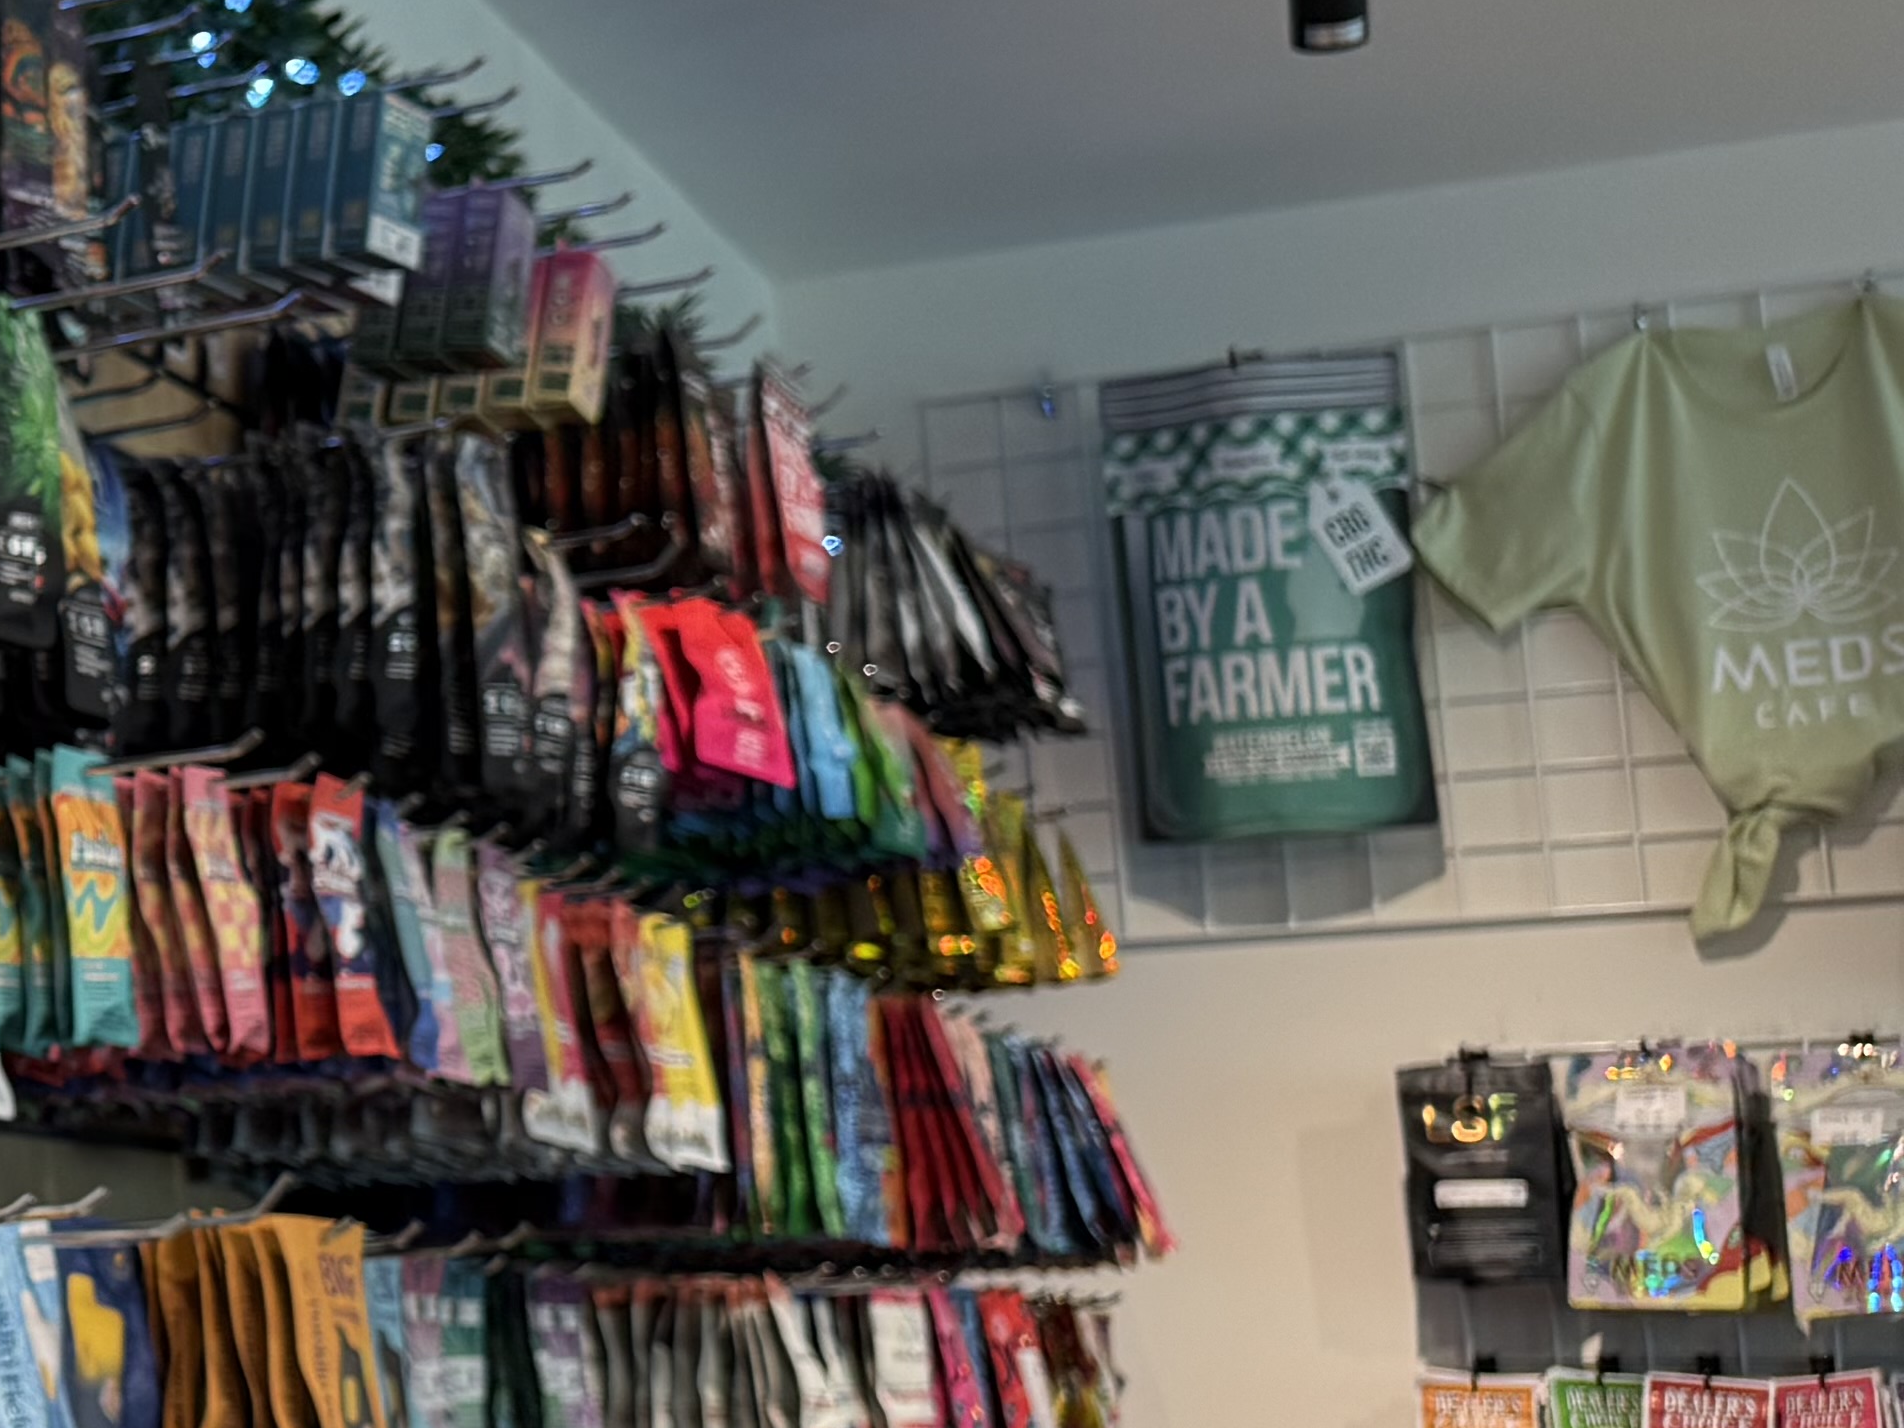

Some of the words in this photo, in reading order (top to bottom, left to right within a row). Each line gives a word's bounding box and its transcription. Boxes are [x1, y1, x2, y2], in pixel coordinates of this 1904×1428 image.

[1153, 500, 1303, 580] MADE
[1344, 536, 1388, 581] THC
[1159, 582, 1218, 649] BY
[1233, 578, 1273, 644] A
[1163, 645, 1381, 728] FARMER
[1710, 630, 1903, 694] MEDS
[1754, 694, 1878, 729] CAFE
[1665, 1386, 1755, 1417] DEALER'S
